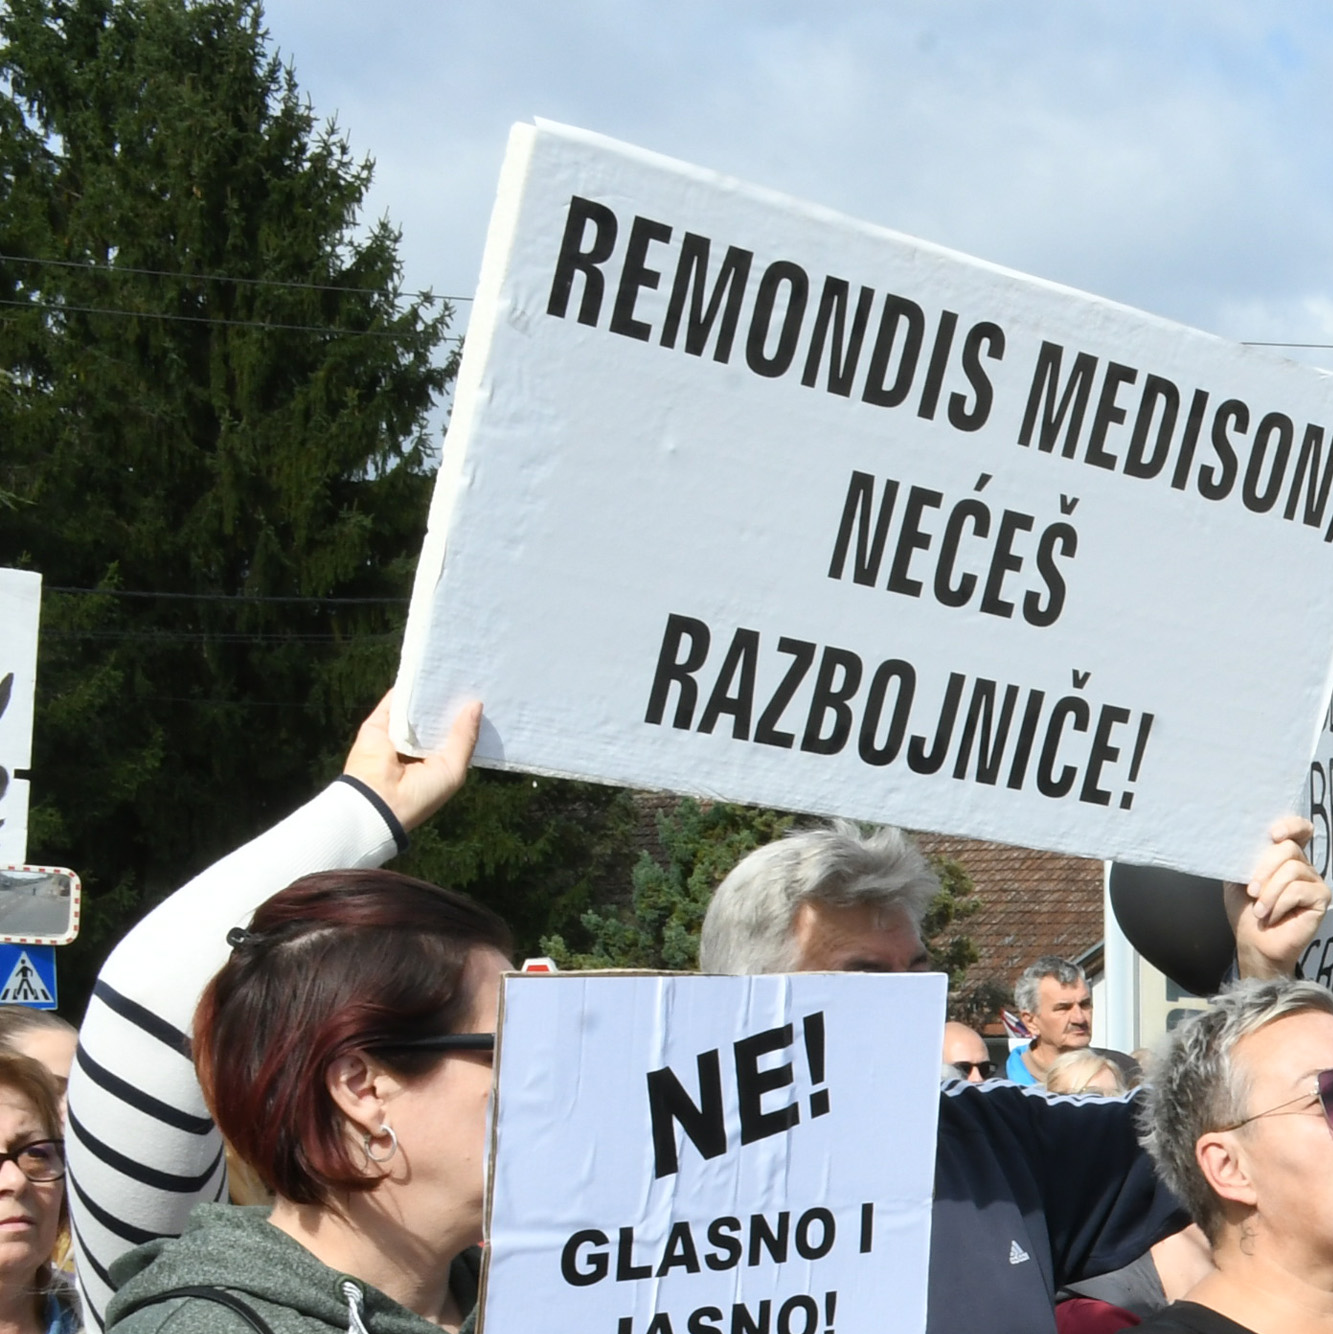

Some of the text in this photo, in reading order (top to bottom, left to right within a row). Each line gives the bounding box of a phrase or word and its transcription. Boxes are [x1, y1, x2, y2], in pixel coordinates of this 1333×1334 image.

[547, 195, 1007, 433] REMONDIS
[828, 471, 1079, 628] NEĆEŠ
[644, 614, 1155, 811] RAZBOJNIČE!
[646, 1011, 830, 1179] NE!
[560, 1202, 874, 1287] GLASNO I
